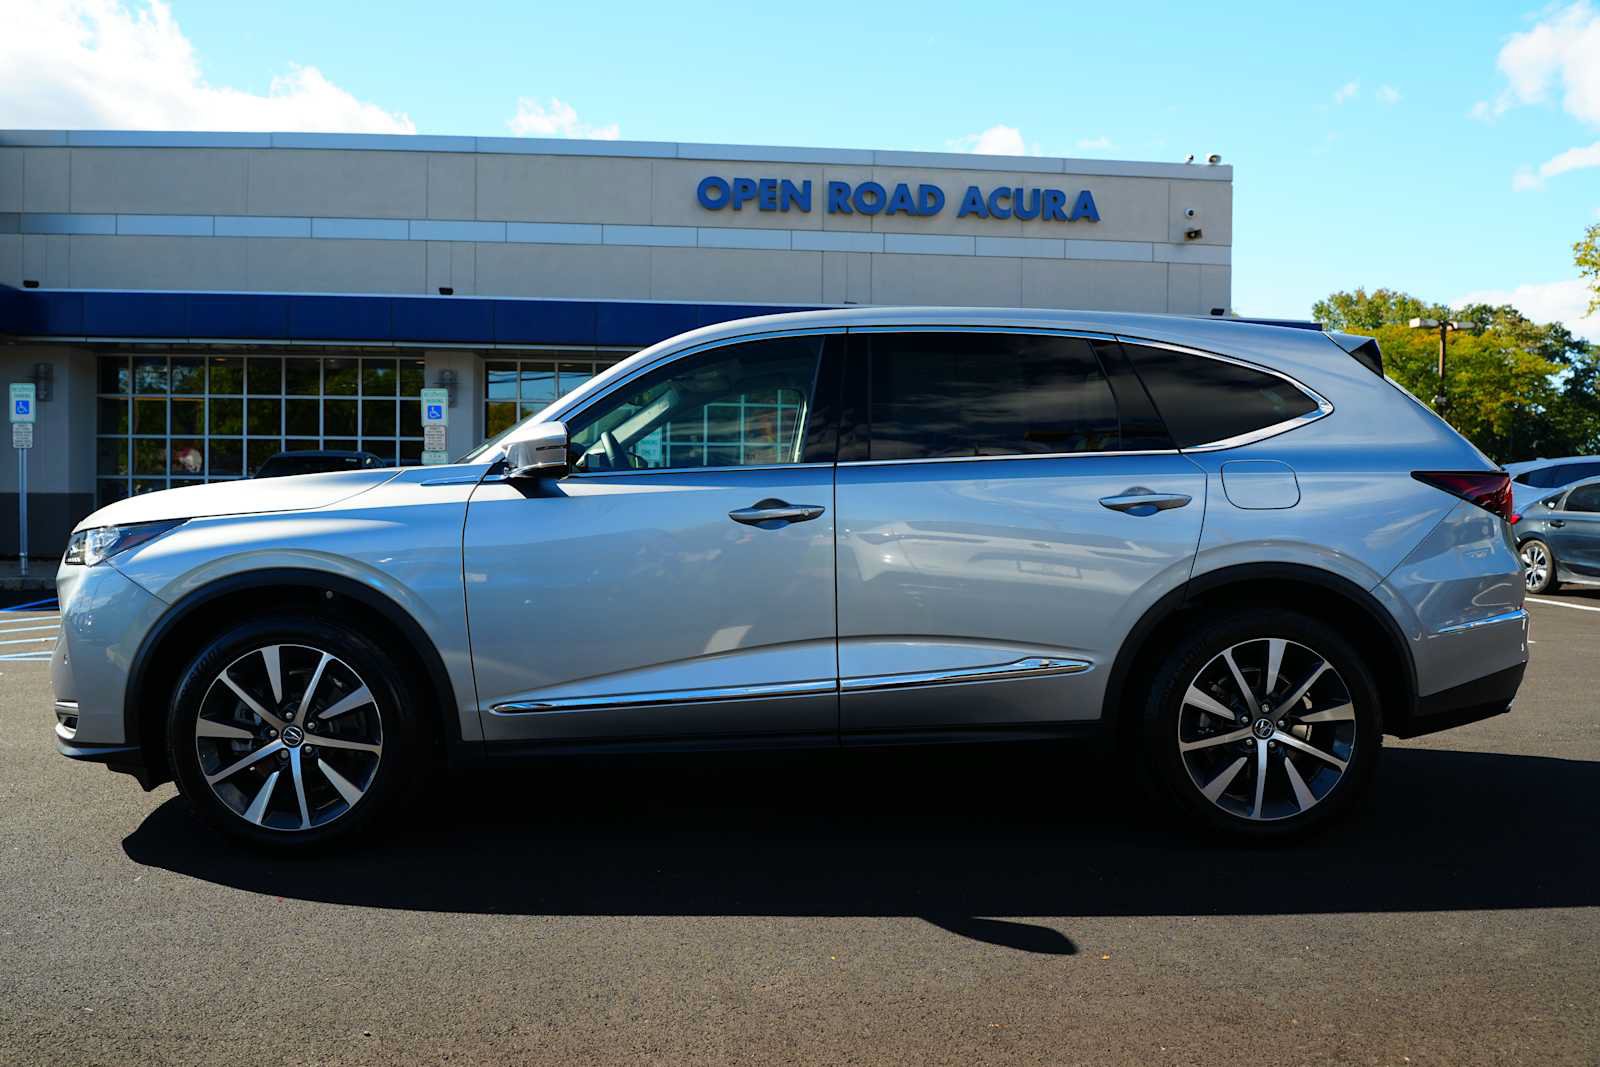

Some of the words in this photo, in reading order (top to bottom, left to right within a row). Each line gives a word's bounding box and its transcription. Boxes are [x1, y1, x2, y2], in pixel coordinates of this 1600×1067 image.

[697, 176, 812, 212] OPEN
[828, 181, 945, 216] ROAD
[957, 185, 1100, 222] ACURA
